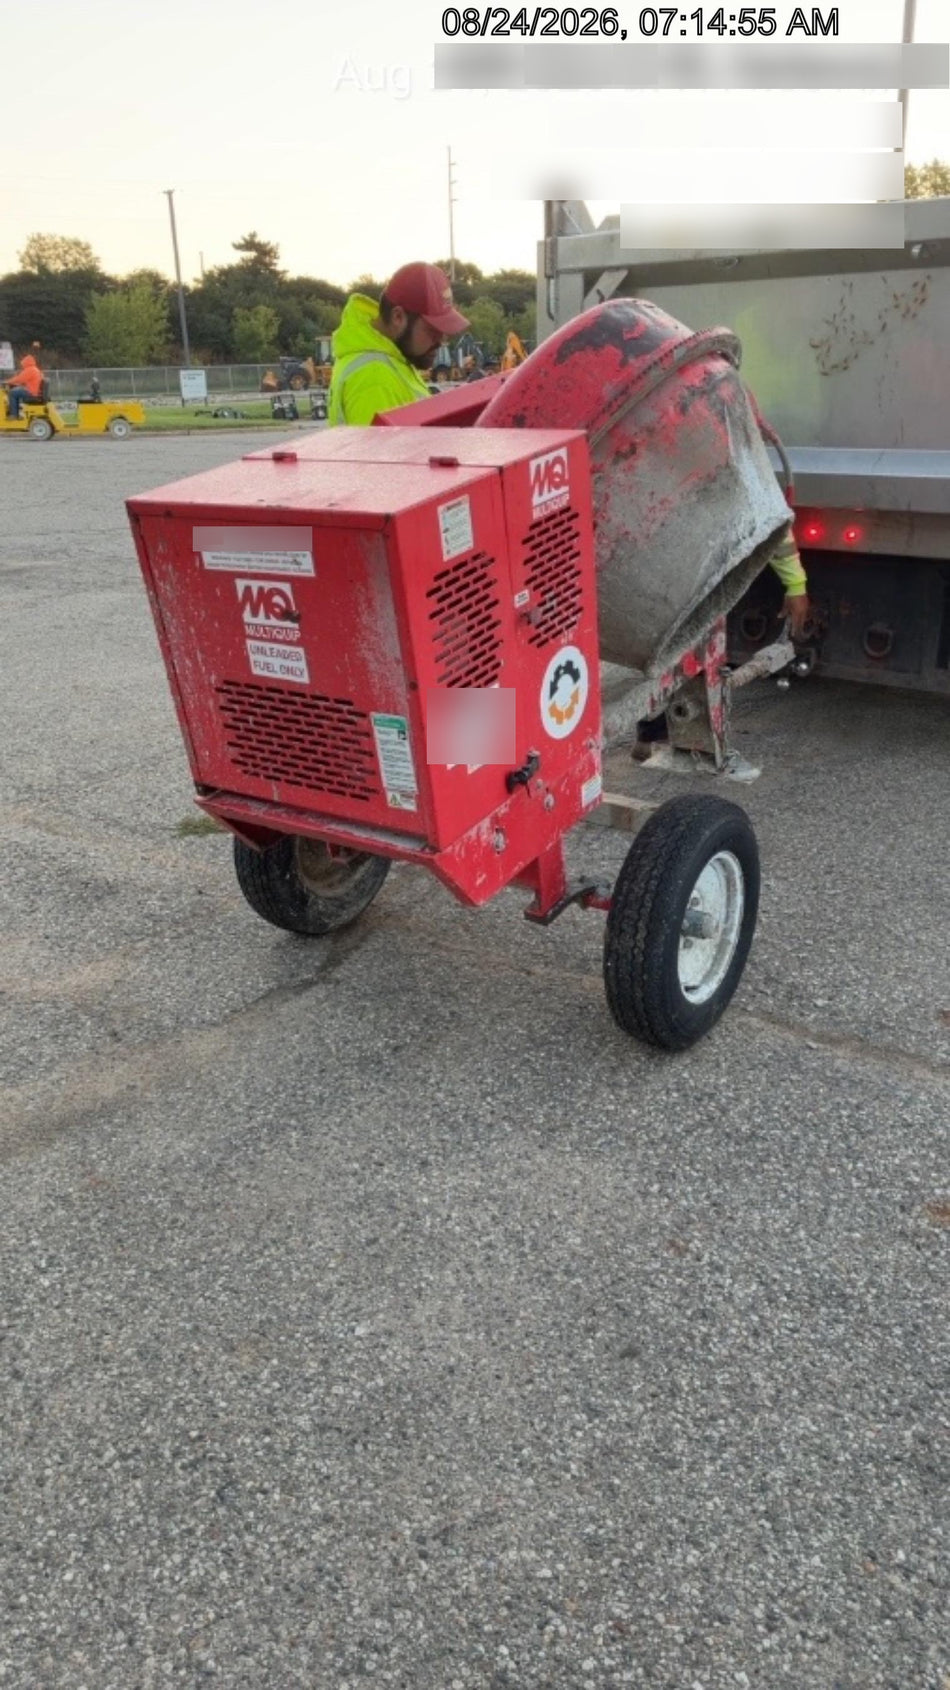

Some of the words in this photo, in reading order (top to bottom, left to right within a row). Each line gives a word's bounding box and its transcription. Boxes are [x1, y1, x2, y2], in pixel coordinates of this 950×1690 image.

[531, 455, 569, 498] MQ
[238, 584, 301, 623] MQ
[249, 644, 303, 662] UNLEADED
[253, 660, 278, 675] FUEL
[279, 664, 305, 679] ONLY
